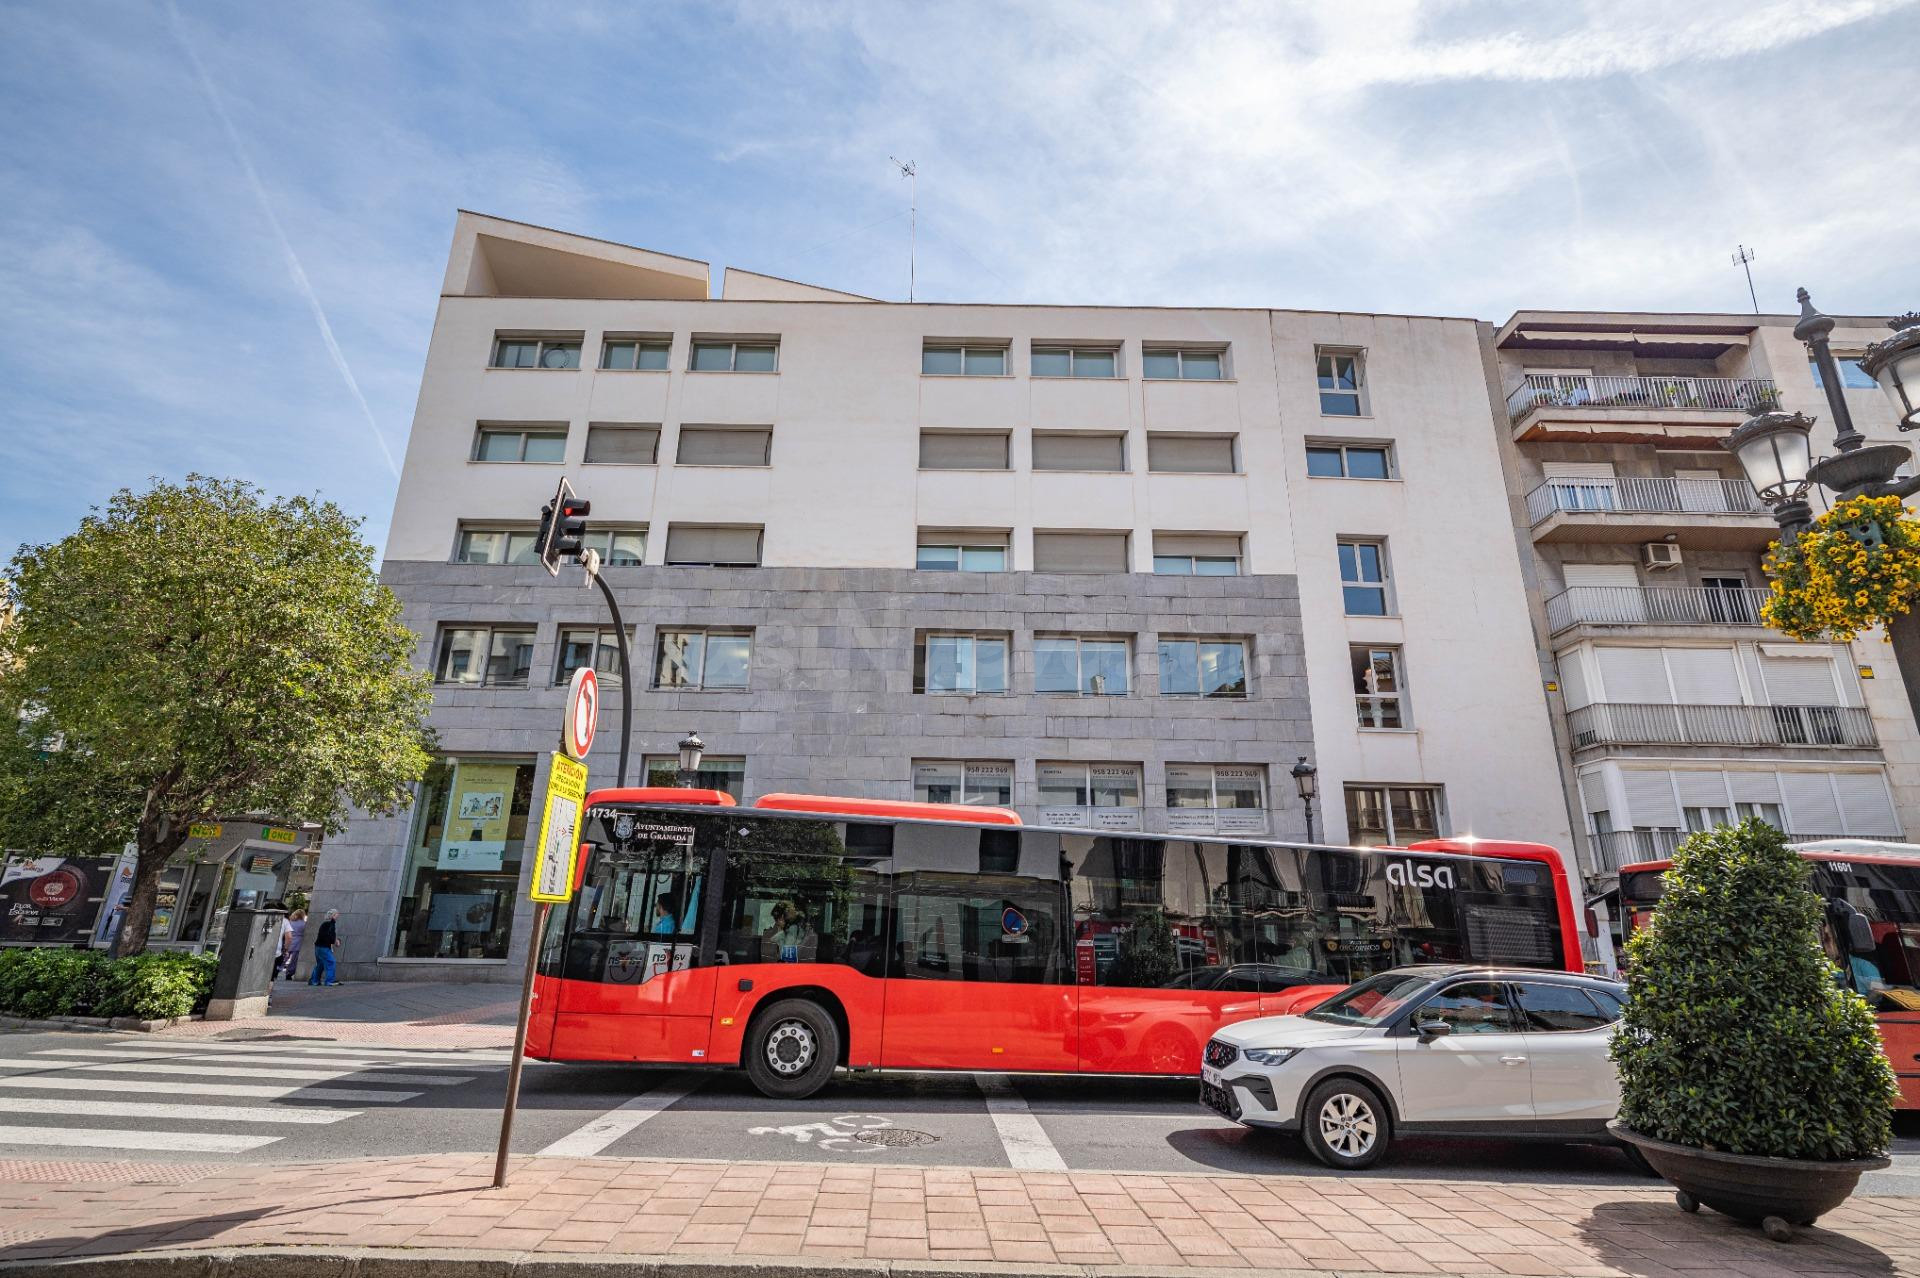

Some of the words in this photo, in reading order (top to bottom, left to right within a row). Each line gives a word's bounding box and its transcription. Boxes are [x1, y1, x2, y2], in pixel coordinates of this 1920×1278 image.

[1120, 768, 1134, 776] 949
[585, 807, 618, 819] 11734
[271, 830, 294, 841] ONCE
[1828, 861, 1853, 873] 11601
[1386, 858, 1454, 889] alsa
